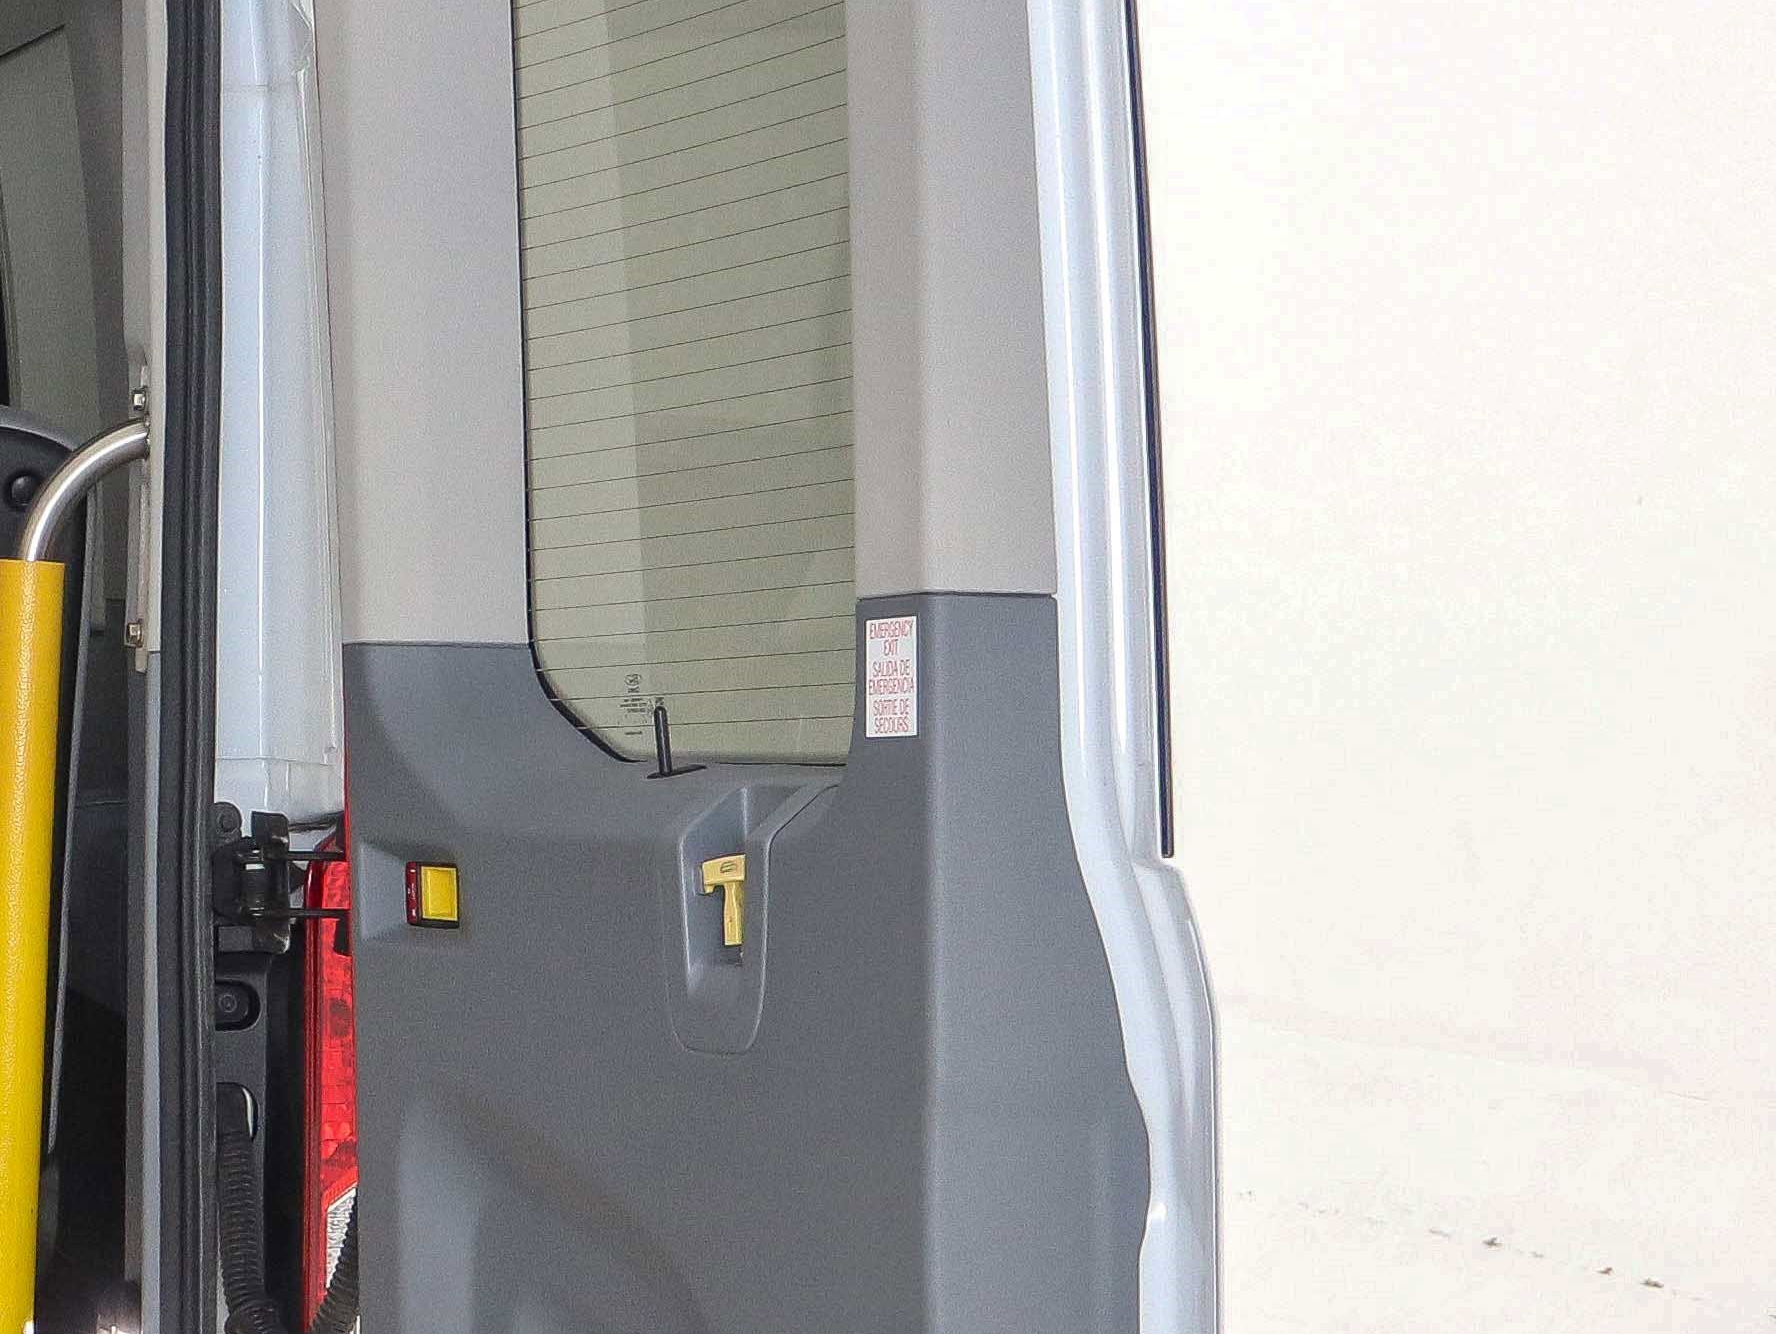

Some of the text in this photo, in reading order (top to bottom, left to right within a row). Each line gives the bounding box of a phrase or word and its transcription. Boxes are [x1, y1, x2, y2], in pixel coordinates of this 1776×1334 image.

[870, 620, 914, 639] EMERGENCY
[883, 639, 898, 656] EXIT
[872, 659, 910, 678] SALIDA DE
[868, 677, 914, 696] EMERGENCIA
[899, 698, 910, 715] DE
